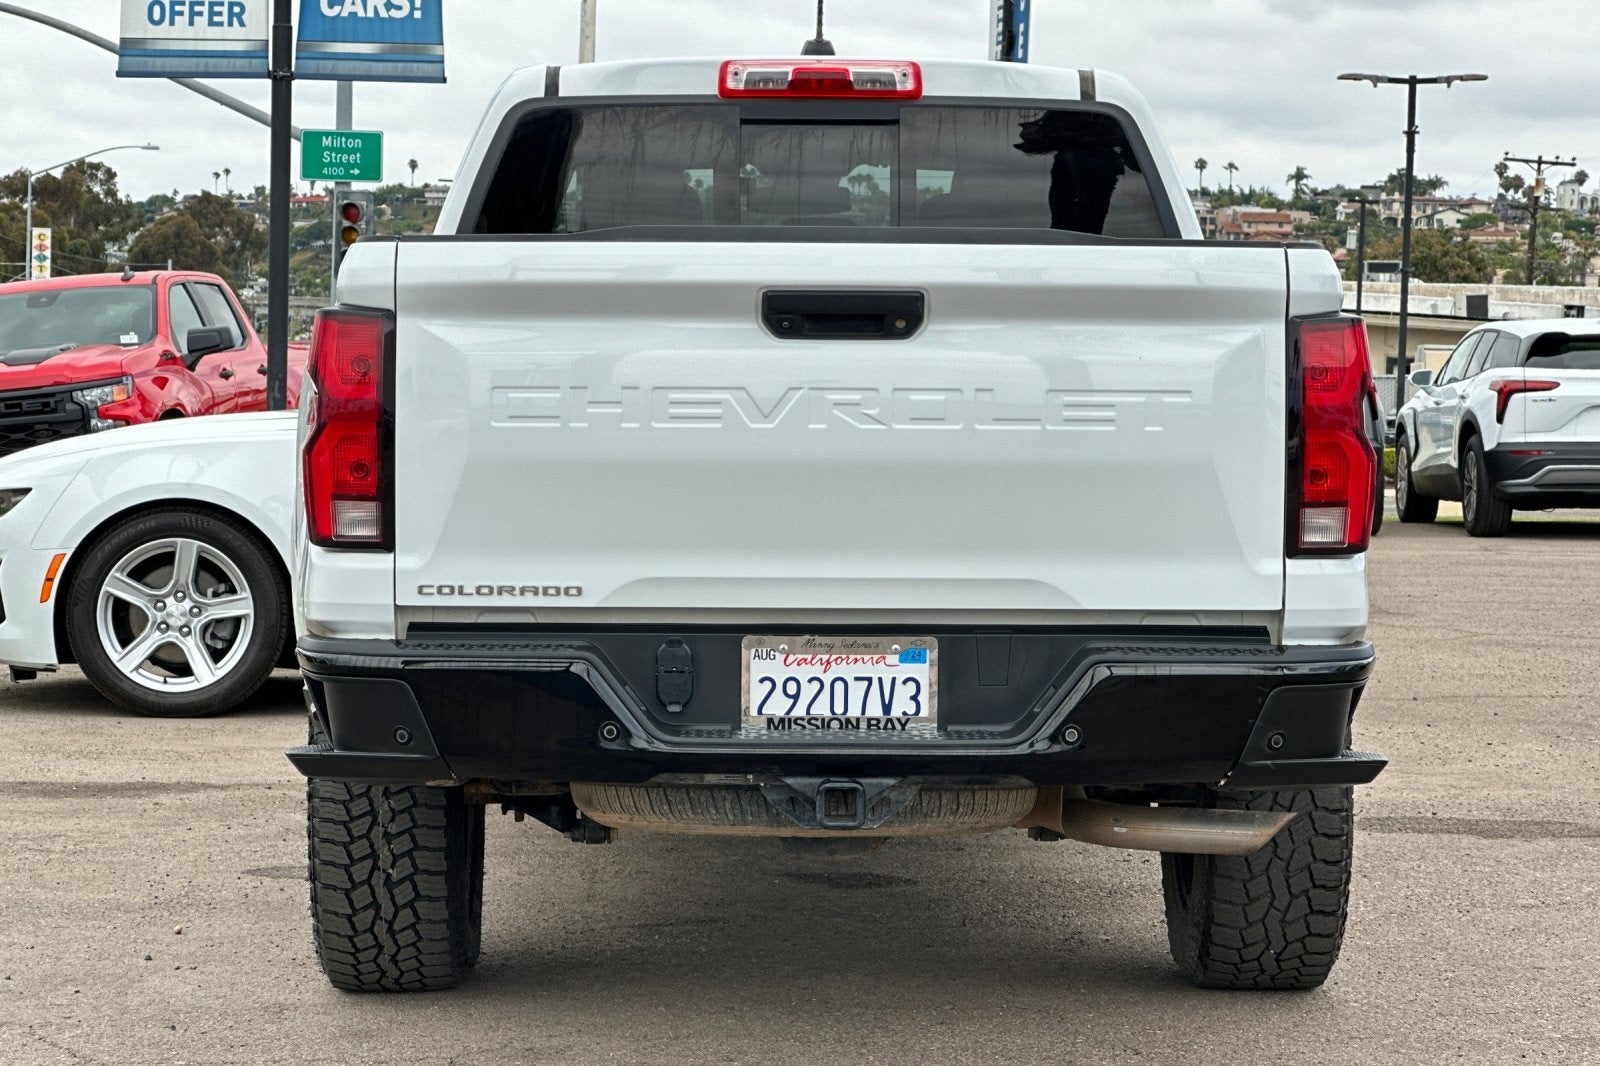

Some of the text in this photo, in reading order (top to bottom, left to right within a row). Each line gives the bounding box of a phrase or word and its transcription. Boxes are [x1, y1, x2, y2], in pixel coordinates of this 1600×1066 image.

[147, 0, 247, 27] OFFER
[320, 0, 422, 18] CARS!
[322, 135, 362, 148] Milton
[322, 151, 361, 163] Street
[322, 167, 345, 176] 4100
[490, 386, 1193, 431] CHEVROLET
[417, 584, 584, 597] COLORADO
[753, 648, 776, 660] AUG
[911, 650, 922, 658] 24
[783, 653, 900, 674] California
[757, 676, 922, 716] 29207V3
[766, 716, 911, 731] MISSION BAY
